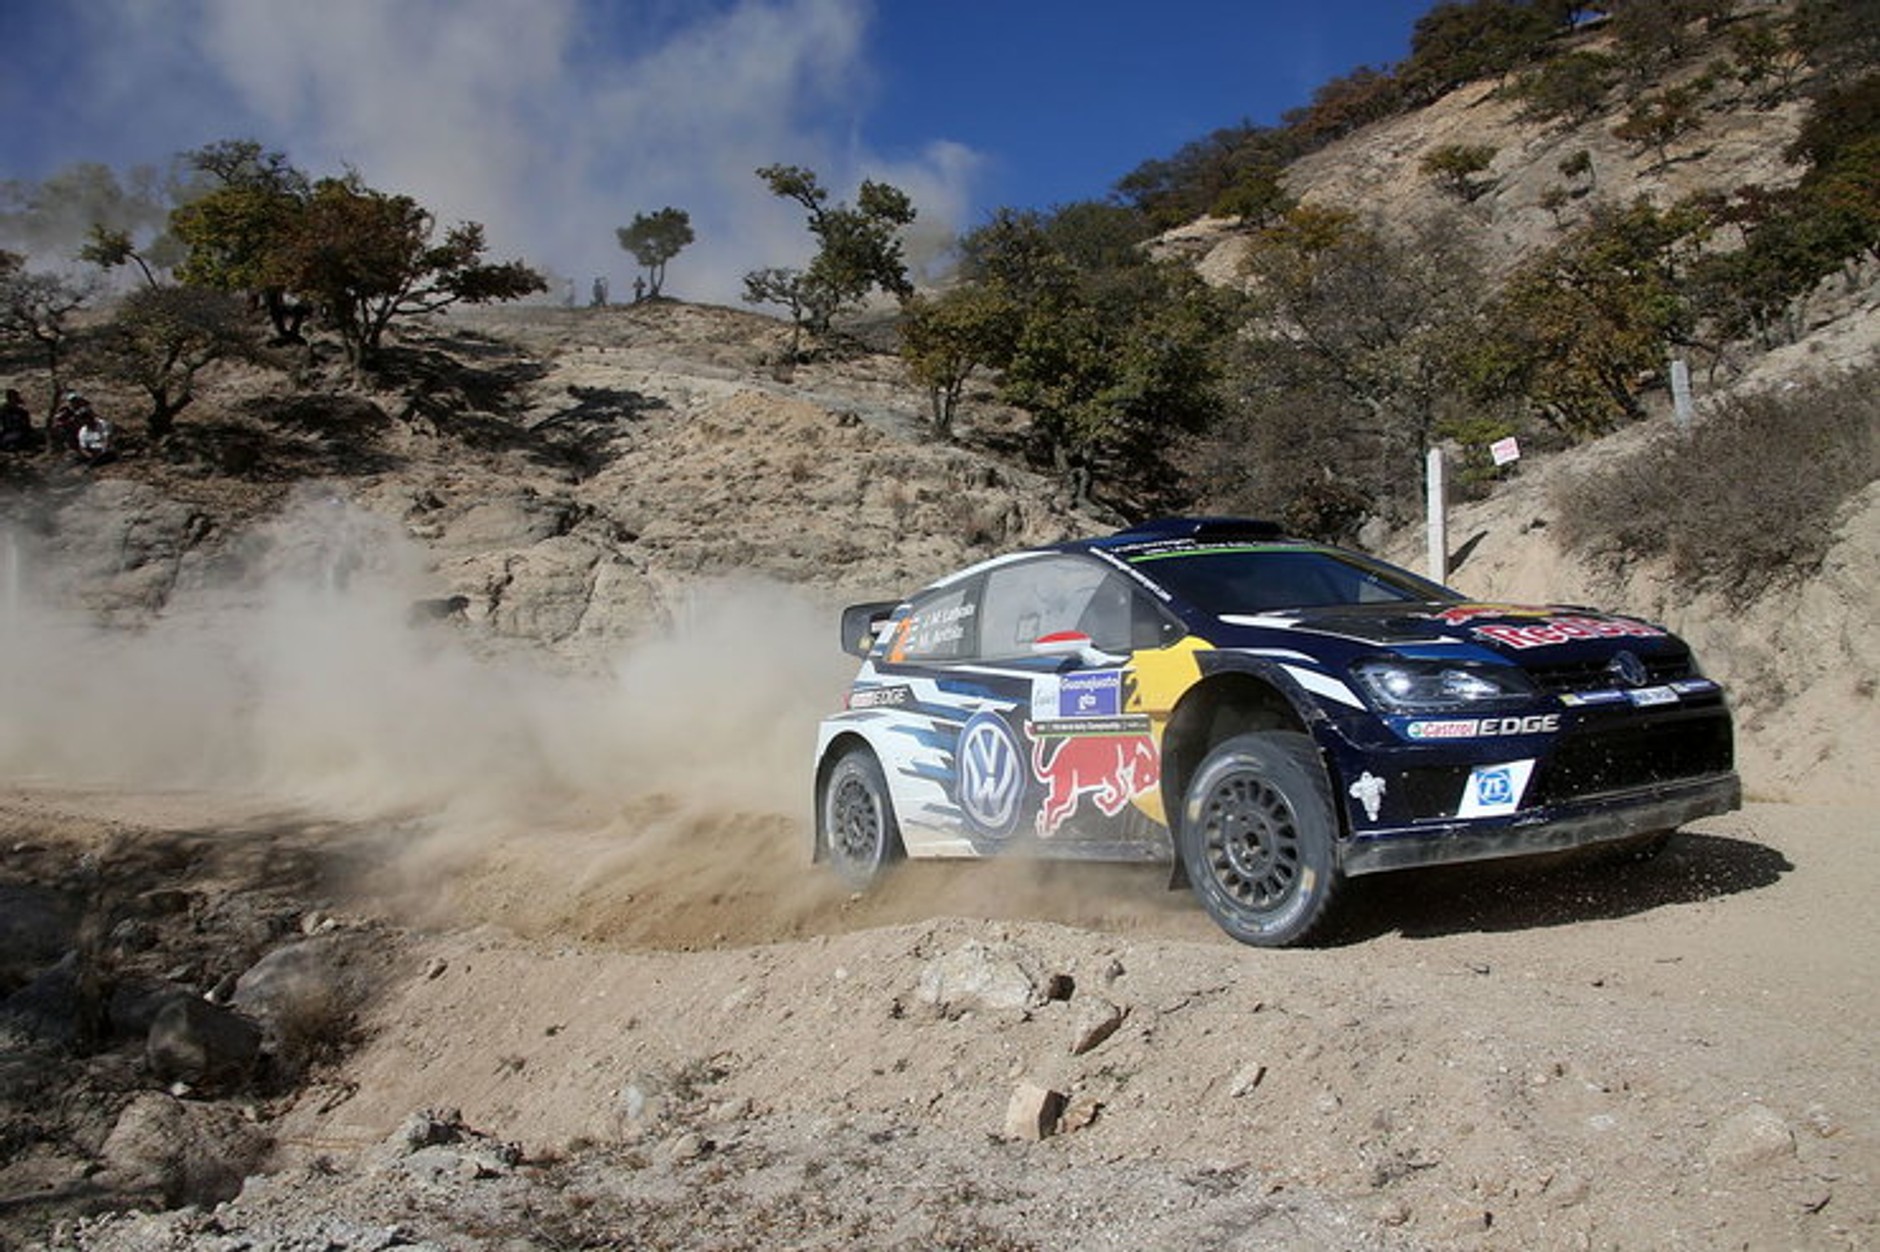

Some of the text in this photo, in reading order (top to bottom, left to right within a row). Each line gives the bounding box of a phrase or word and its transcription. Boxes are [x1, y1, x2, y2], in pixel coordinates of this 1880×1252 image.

[1060, 675, 1119, 692] Guanajuato
[873, 688, 908, 705] EDGE
[1423, 714, 1560, 737] Castrol EDGE
